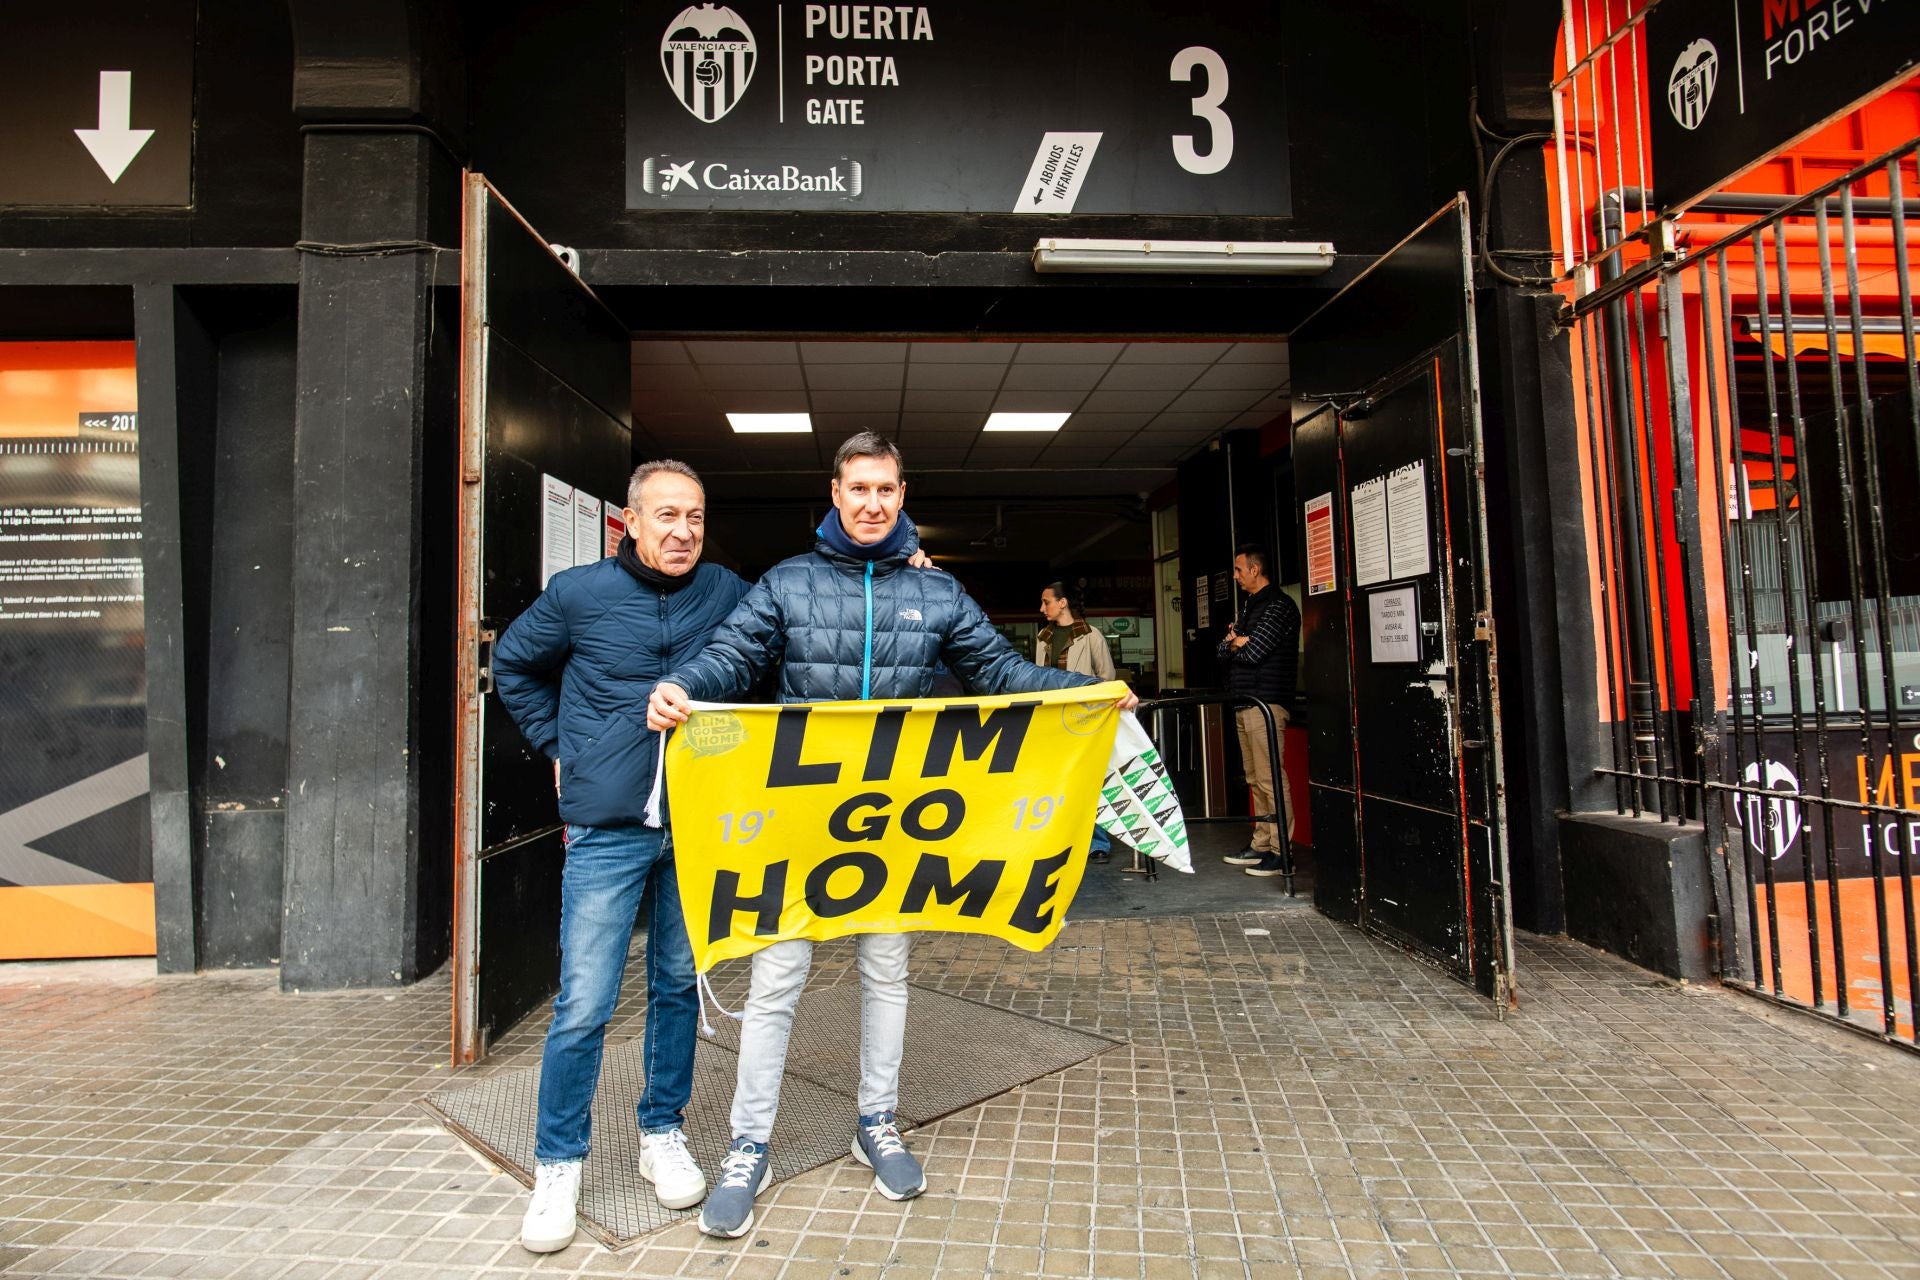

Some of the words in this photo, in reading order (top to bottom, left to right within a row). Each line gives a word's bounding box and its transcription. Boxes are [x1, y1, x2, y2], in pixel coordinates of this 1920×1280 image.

[806, 4, 934, 41] PUERTA
[1765, 0, 1885, 80] FORE
[669, 42, 725, 51] VALENCIA
[729, 43, 750, 51] C.F.
[806, 55, 899, 86] PORTA
[806, 98, 865, 125] GATE
[1169, 46, 1234, 175] 3
[703, 163, 847, 192] CaixaBank
[1040, 144, 1064, 186] ABONOS
[1052, 144, 1084, 200] INFANTILES
[693, 727, 710, 736] GO
[698, 733, 740, 746] HOME
[702, 716, 726, 727] LIM
[766, 699, 1043, 788] LIM
[717, 808, 776, 846] 19'
[828, 788, 966, 843] GO
[1012, 795, 1065, 832] 19'
[707, 845, 1074, 946] HOME
